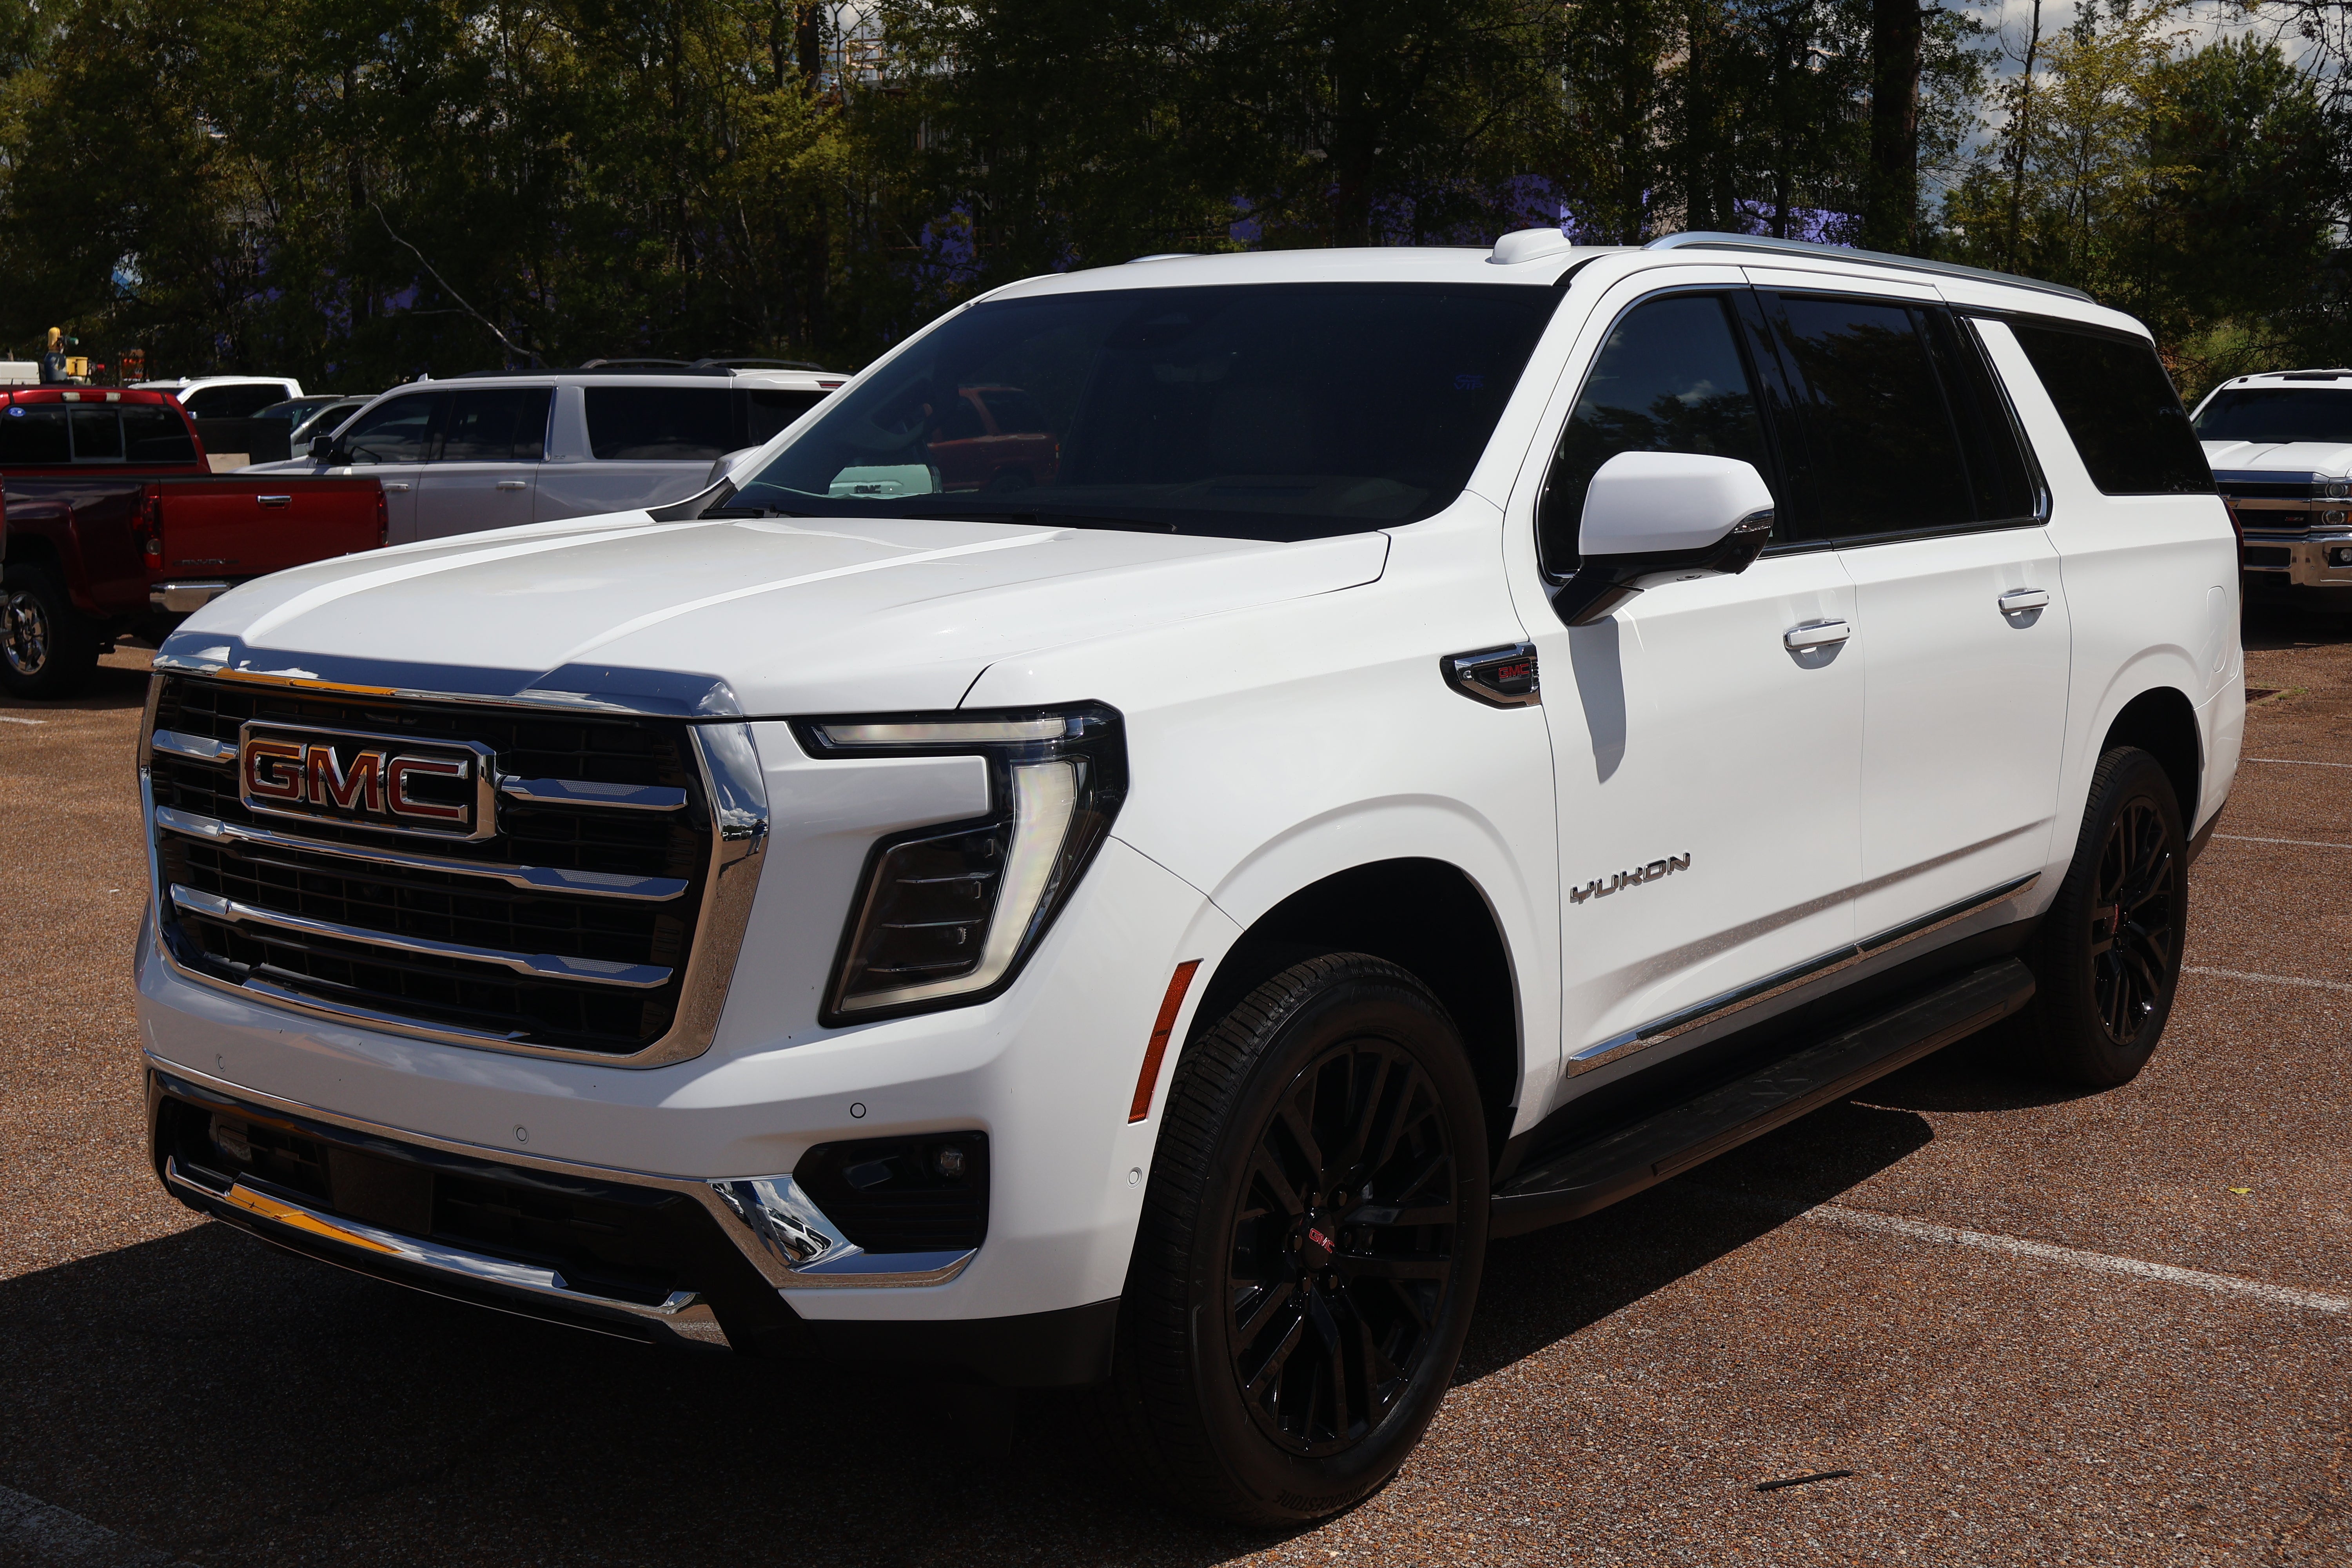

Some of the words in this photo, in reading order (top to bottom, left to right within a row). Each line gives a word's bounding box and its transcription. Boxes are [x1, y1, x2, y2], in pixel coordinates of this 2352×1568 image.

[1499, 663, 1529, 679] GMC
[246, 738, 468, 824] GMC
[1570, 852, 1691, 903] YUKON
[1309, 1228, 1335, 1254] GMC
[1273, 1481, 1368, 1512] BRIDGESTONE
